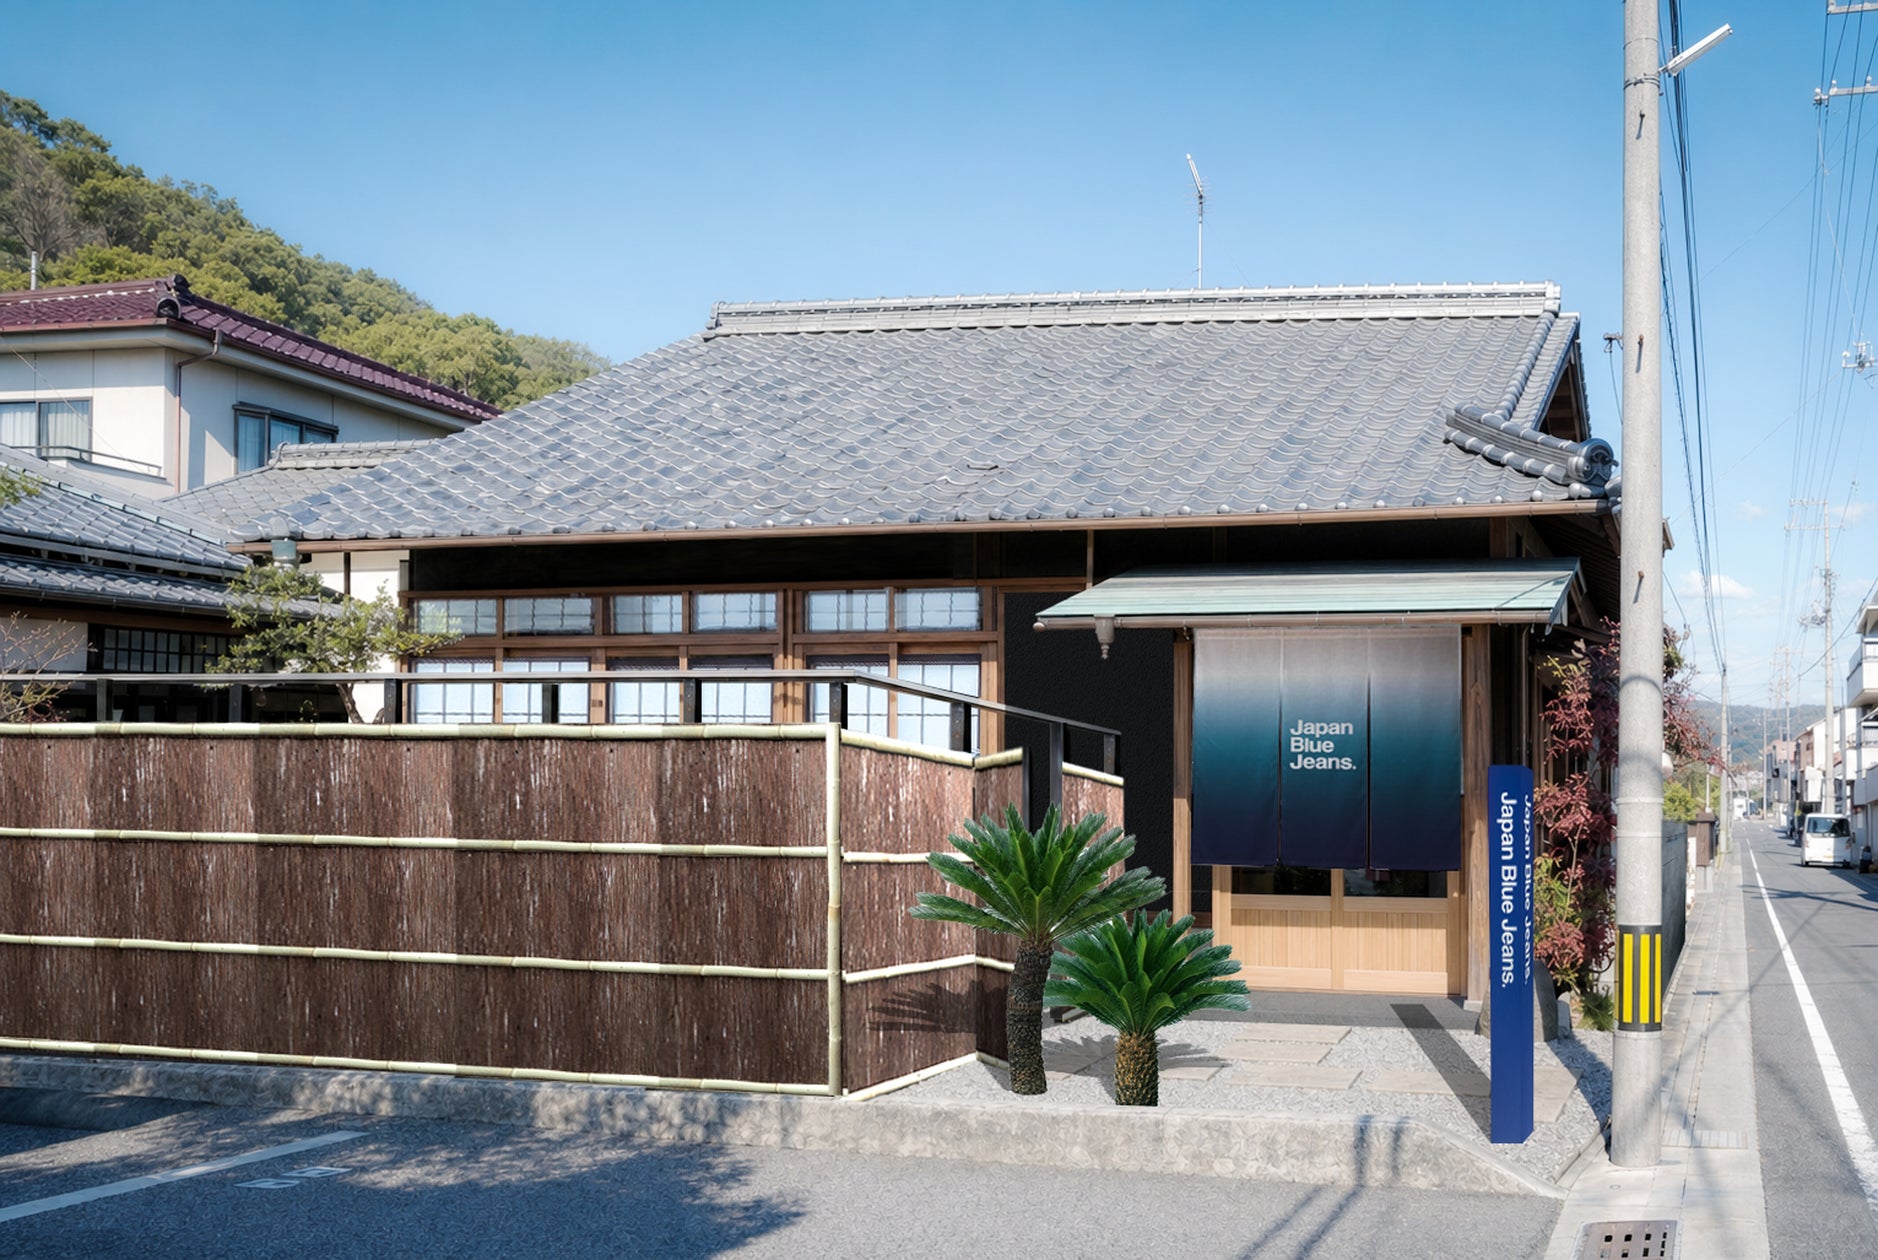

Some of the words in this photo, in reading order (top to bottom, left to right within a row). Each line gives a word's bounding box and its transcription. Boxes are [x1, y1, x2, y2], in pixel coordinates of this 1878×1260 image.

[1289, 719, 1354, 738] Japan
[1290, 736, 1335, 753] Blue
[1289, 754, 1357, 771] Jeans.
[1497, 792, 1518, 860] Japan
[1523, 794, 1532, 859] Japan
[1501, 866, 1518, 914] Blue
[1524, 864, 1532, 911] Blue
[1501, 918, 1518, 988] Jeans.
